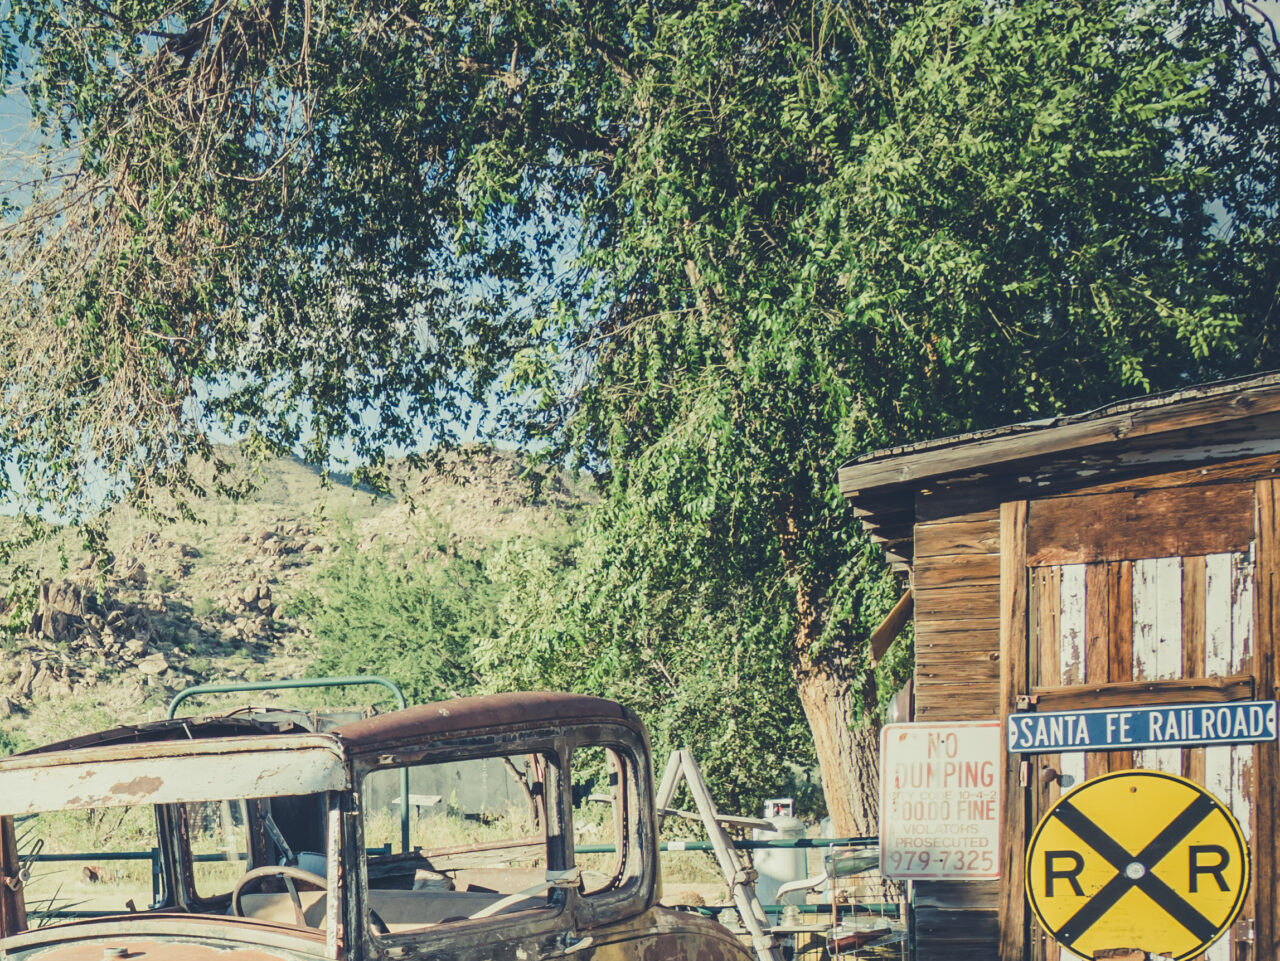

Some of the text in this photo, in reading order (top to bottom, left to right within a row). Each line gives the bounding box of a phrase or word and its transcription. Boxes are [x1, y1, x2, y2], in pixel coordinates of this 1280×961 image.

[1020, 706, 1264, 747] SANTA FE RAILROAD
[928, 732, 958, 759] NO
[895, 760, 994, 789] DUMPING
[957, 800, 996, 820] FINE
[903, 824, 979, 834] VIOLATORS
[895, 837, 989, 848] PROSECUTED
[890, 850, 993, 871] 979-7325
[1044, 844, 1231, 897] R R
